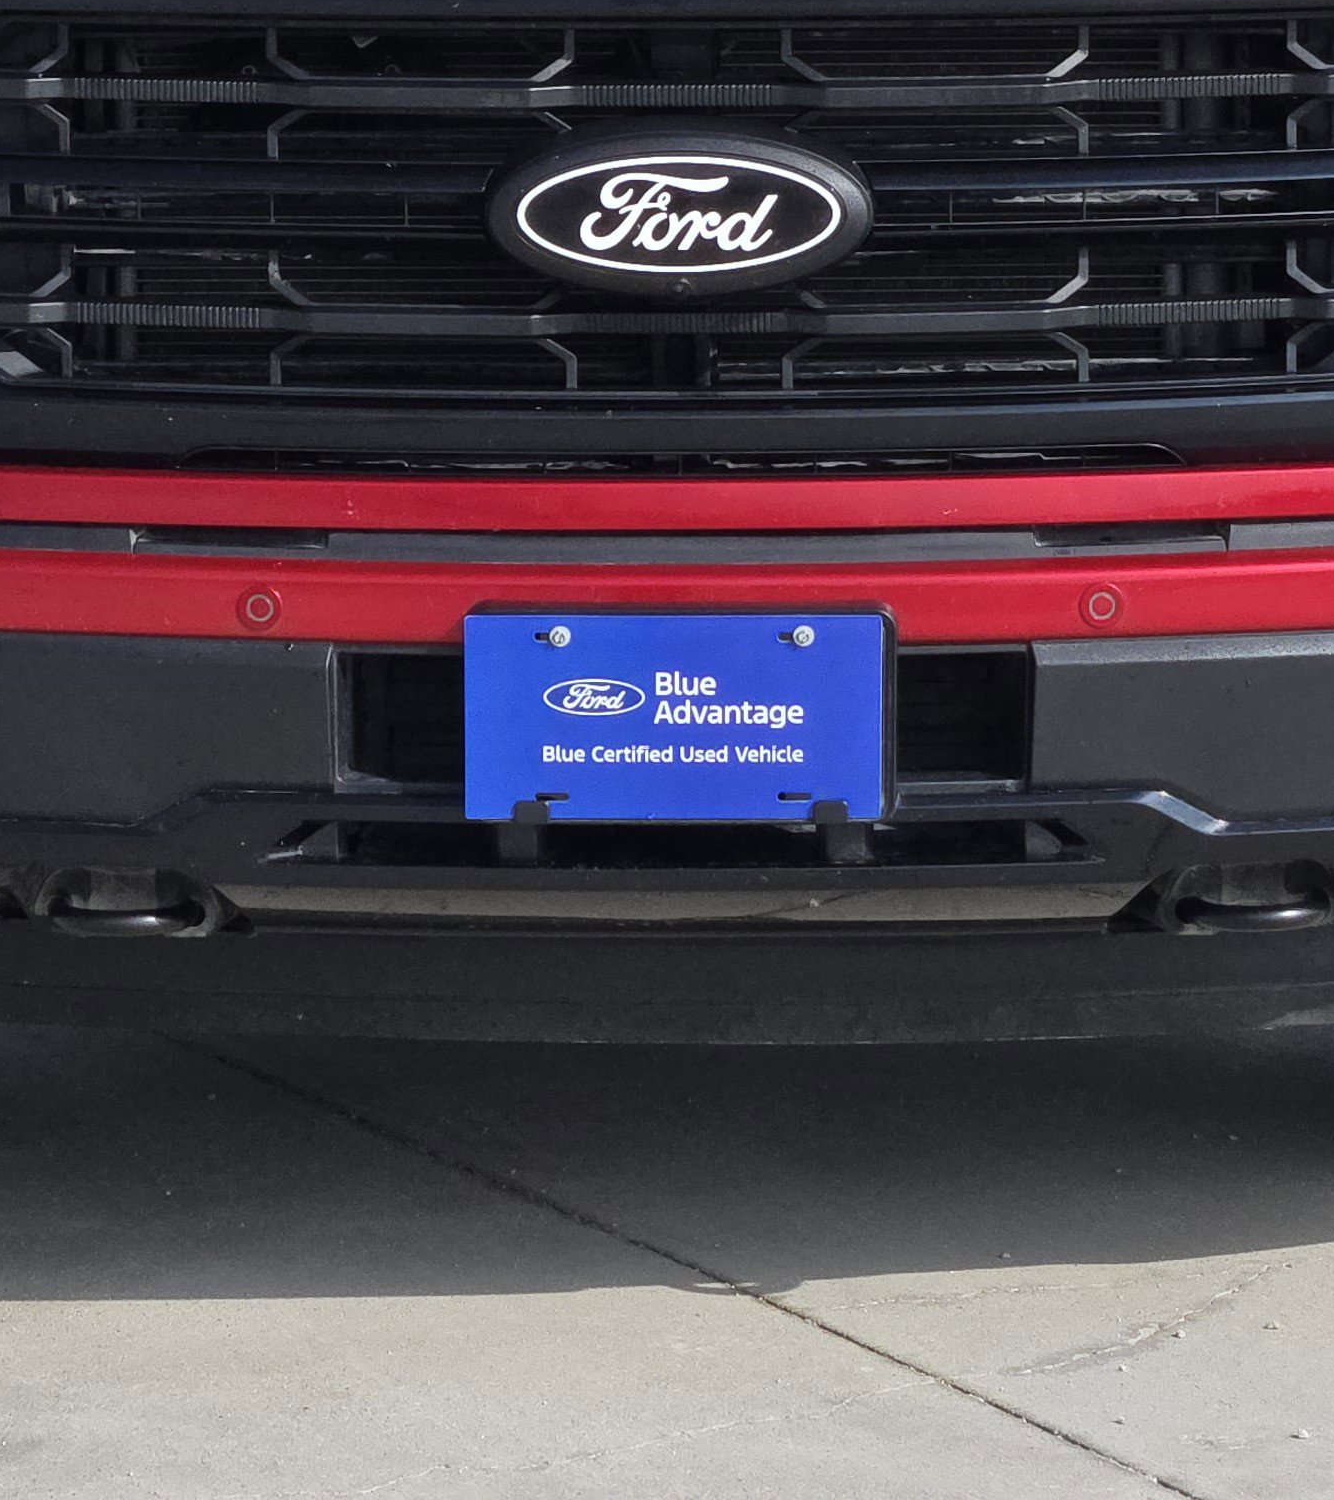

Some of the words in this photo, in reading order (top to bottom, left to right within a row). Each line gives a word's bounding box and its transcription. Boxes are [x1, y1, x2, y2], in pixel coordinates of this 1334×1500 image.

[579, 172, 779, 252] Ford
[562, 682, 626, 710] Ford
[654, 671, 717, 697] Blue
[653, 699, 804, 729] Advantage
[542, 745, 586, 763] Blue
[591, 745, 673, 763] Certified
[679, 745, 729, 763] Used
[735, 744, 804, 763] Vehicle
